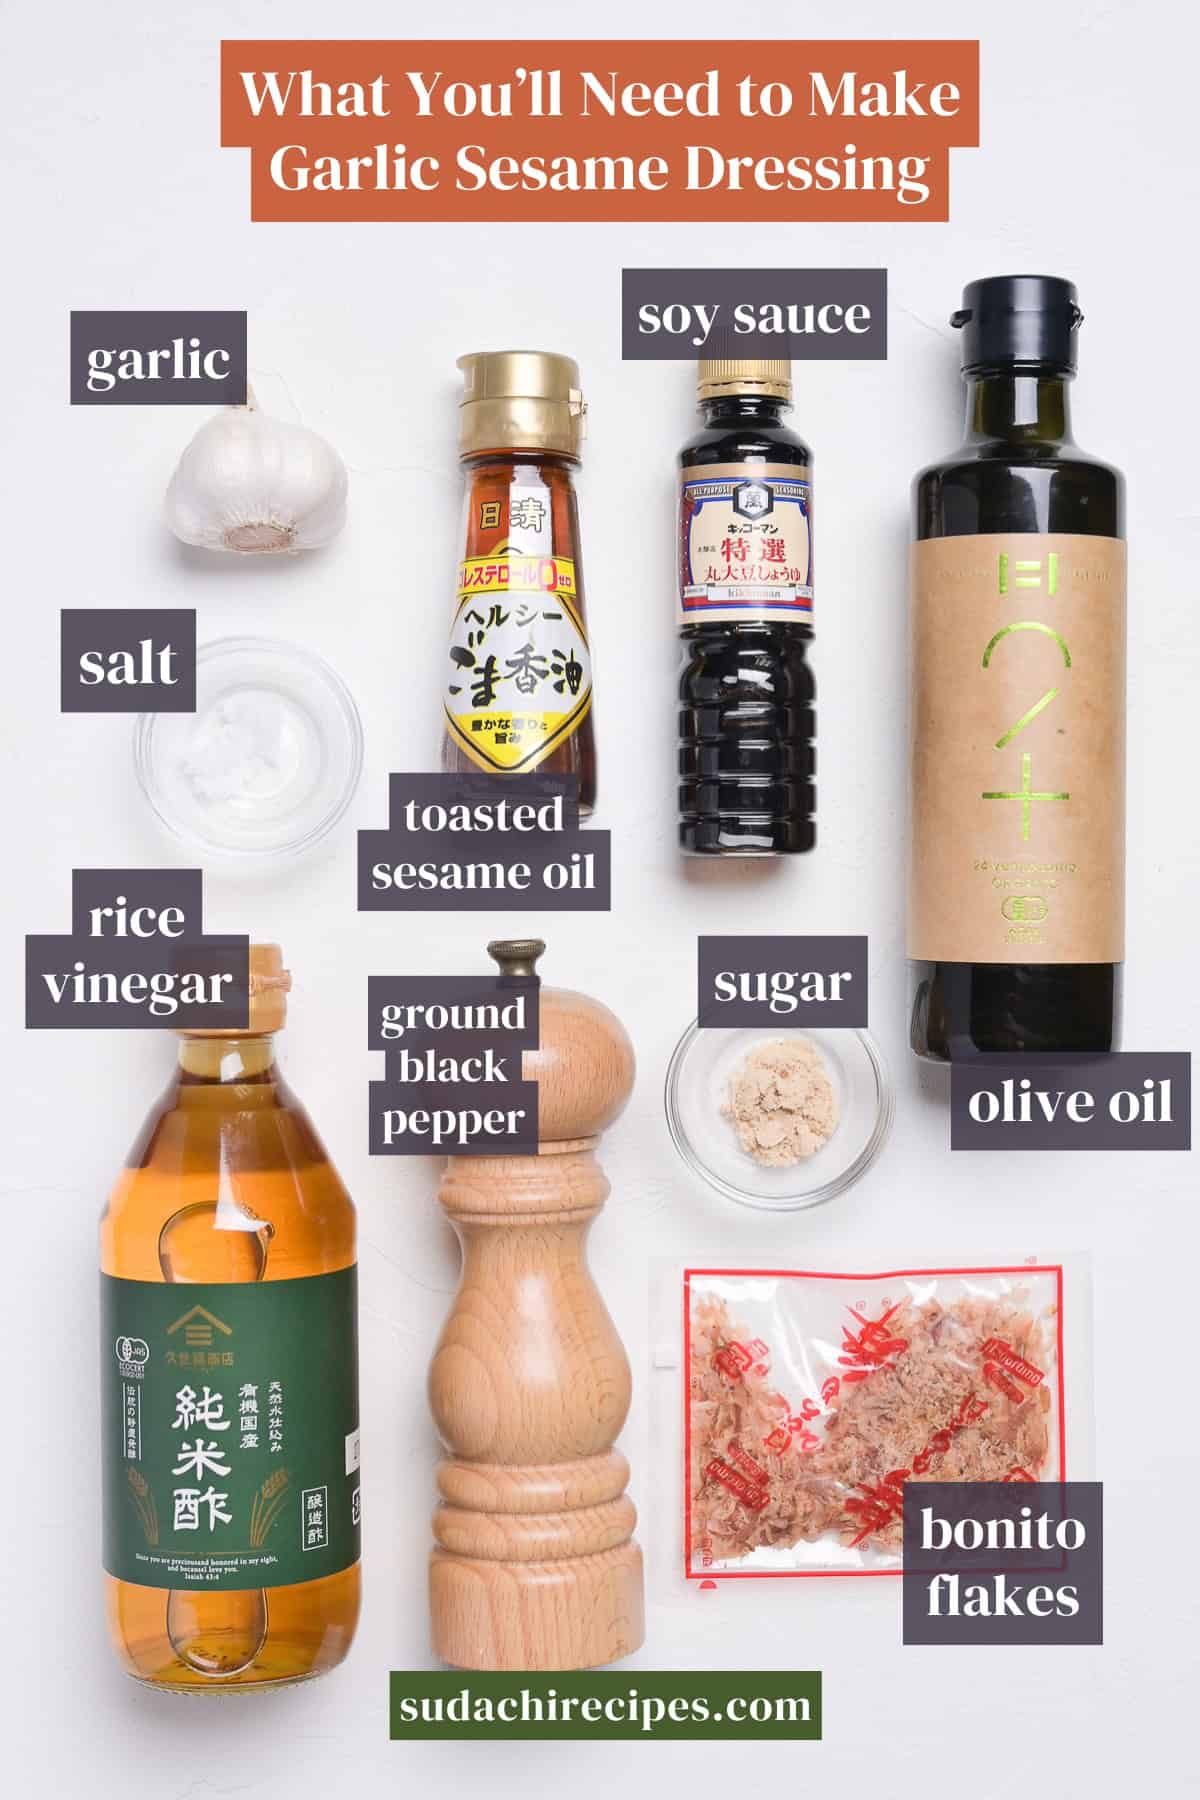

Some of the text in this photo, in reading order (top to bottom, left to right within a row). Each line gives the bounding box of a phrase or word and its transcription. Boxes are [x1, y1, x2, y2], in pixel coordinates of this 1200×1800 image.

[479, 497, 547, 534] 日清
[727, 523, 779, 534] キッコーマン
[720, 537, 787, 563] 特選
[463, 604, 563, 628] ヘルシー
[171, 1384, 233, 1532] 純米酢
